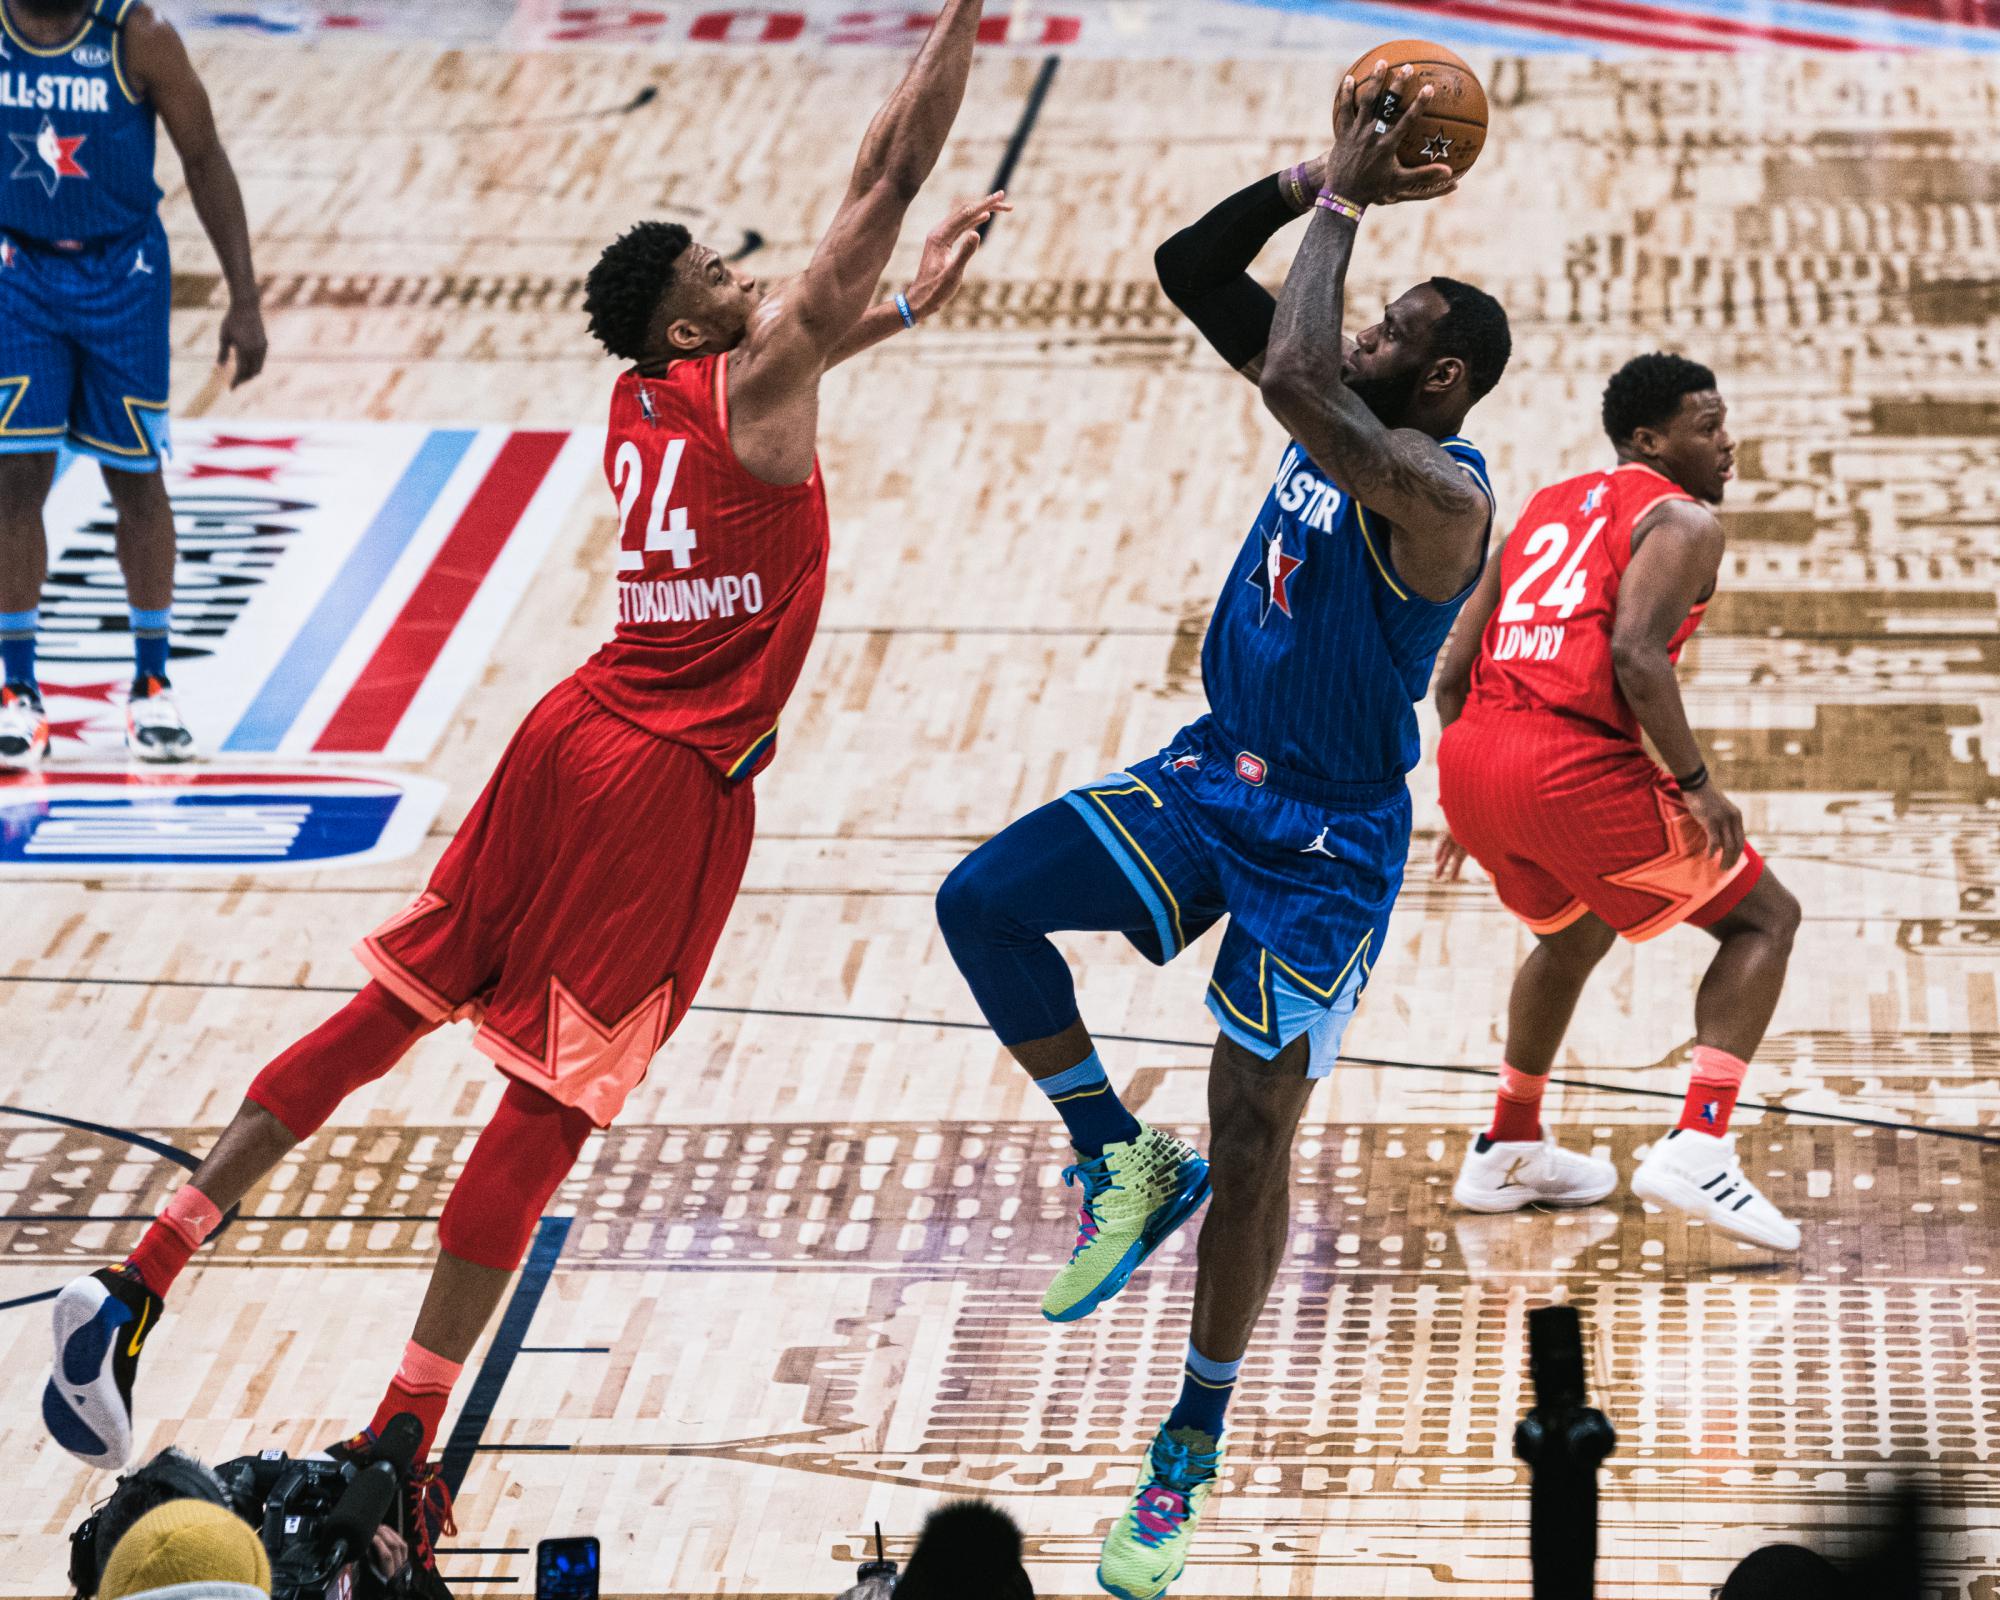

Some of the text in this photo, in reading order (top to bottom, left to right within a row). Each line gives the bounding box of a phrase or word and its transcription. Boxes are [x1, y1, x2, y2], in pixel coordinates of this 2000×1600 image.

[548, 10, 1081, 44] 2020
[77, 47, 108, 63] KIA
[615, 438, 698, 571] 24
[1498, 516, 1607, 623] 24
[618, 572, 763, 625] TOKOUNMPO
[1492, 624, 1565, 661] LOWRY
